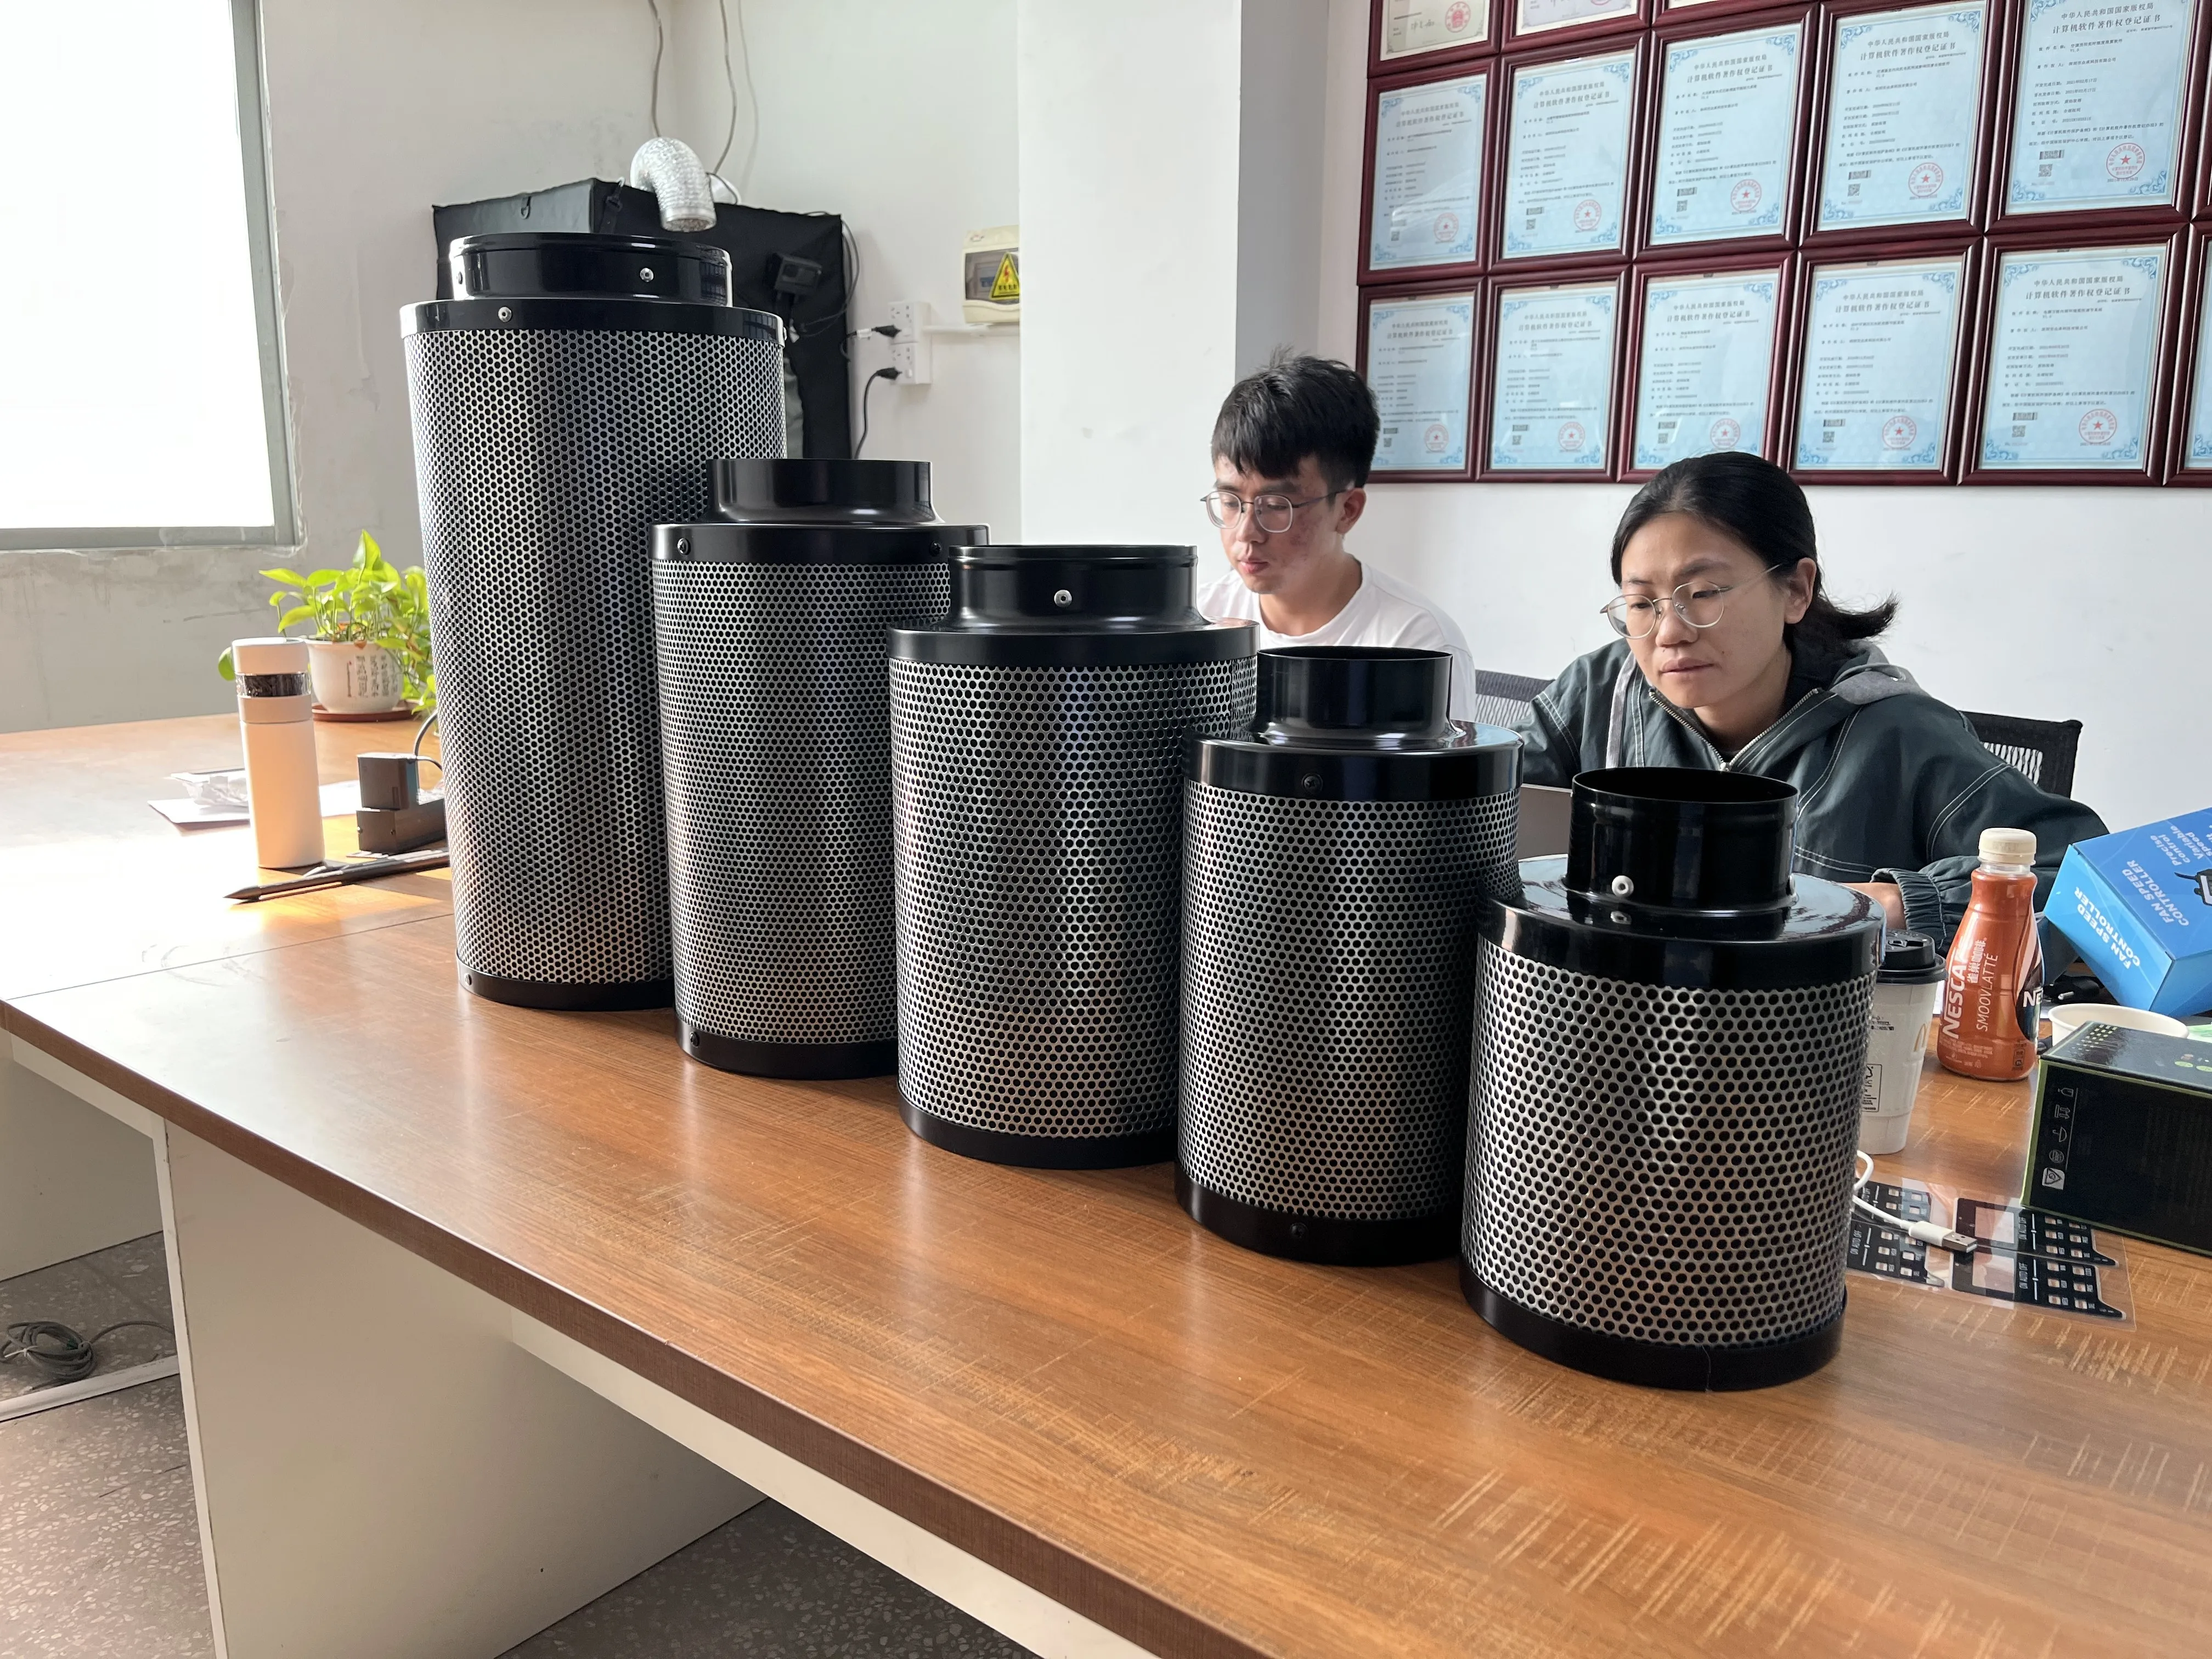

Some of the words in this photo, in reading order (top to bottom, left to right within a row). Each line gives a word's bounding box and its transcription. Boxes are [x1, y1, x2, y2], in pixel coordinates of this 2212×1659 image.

[2061, 2, 2154, 20] 中华人民共和国国家版权局
[2052, 14, 2161, 34] 计算机软件著作权登记证书
[1867, 31, 1949, 47] 中华人民共和国国家版权局
[1860, 42, 1956, 61] 计算机软件著作权登记证书
[1687, 65, 1773, 83] 计算机软件著作权登记证书
[2034, 275, 2124, 287] 中华人民共和国国家版权局
[2025, 287, 2131, 300] 计算机软件著作权登记证书
[1835, 301, 1930, 313] 计算机软件著作权登记证书
[2150, 834, 2182, 866] Precise
[2158, 834, 2191, 864] control
[2170, 825, 2204, 860] Variable
[2122, 868, 2155, 900] SPEED
[2126, 859, 2190, 926] CONTROLLER
[2076, 903, 2110, 944] SPEED
[2151, 902, 2174, 923] FAN
[2074, 886, 2141, 967] CONTROLLER
[1967, 939, 1986, 984] 雀巢咖啡
[2110, 943, 2131, 969] FAN
